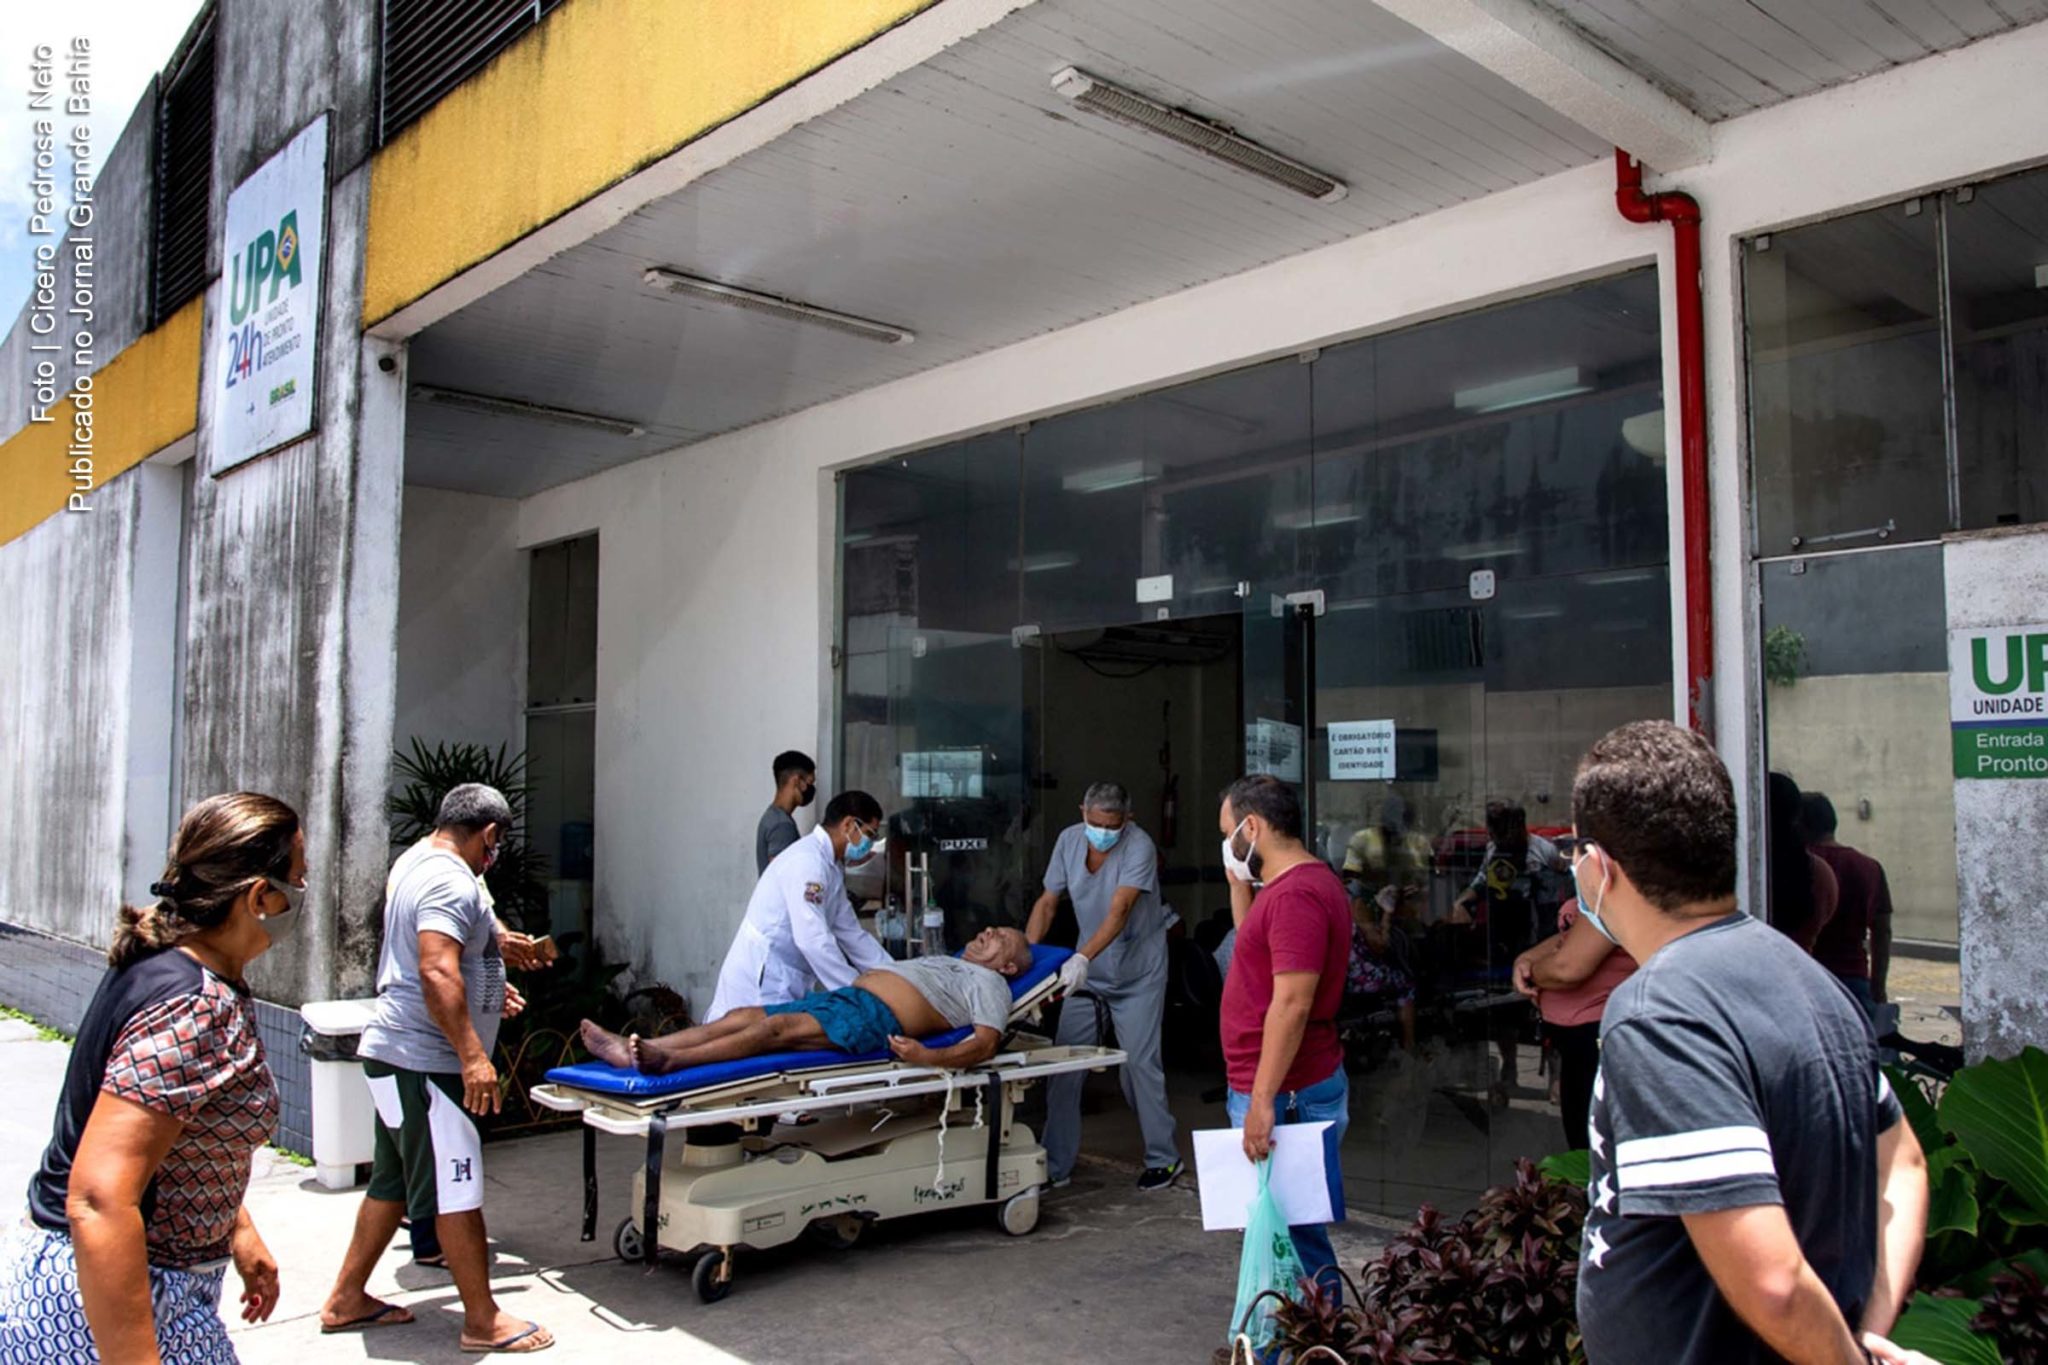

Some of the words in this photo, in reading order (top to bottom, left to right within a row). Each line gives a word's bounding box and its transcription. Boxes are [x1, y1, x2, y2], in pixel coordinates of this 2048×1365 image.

[230, 208, 302, 327] UPA
[226, 320, 262, 390] 24h
[1972, 697, 2044, 715] UNIDADE
[1976, 732, 2044, 748] Entrada
[1977, 755, 2048, 772] Pronto
[942, 839, 986, 850] PUXE
